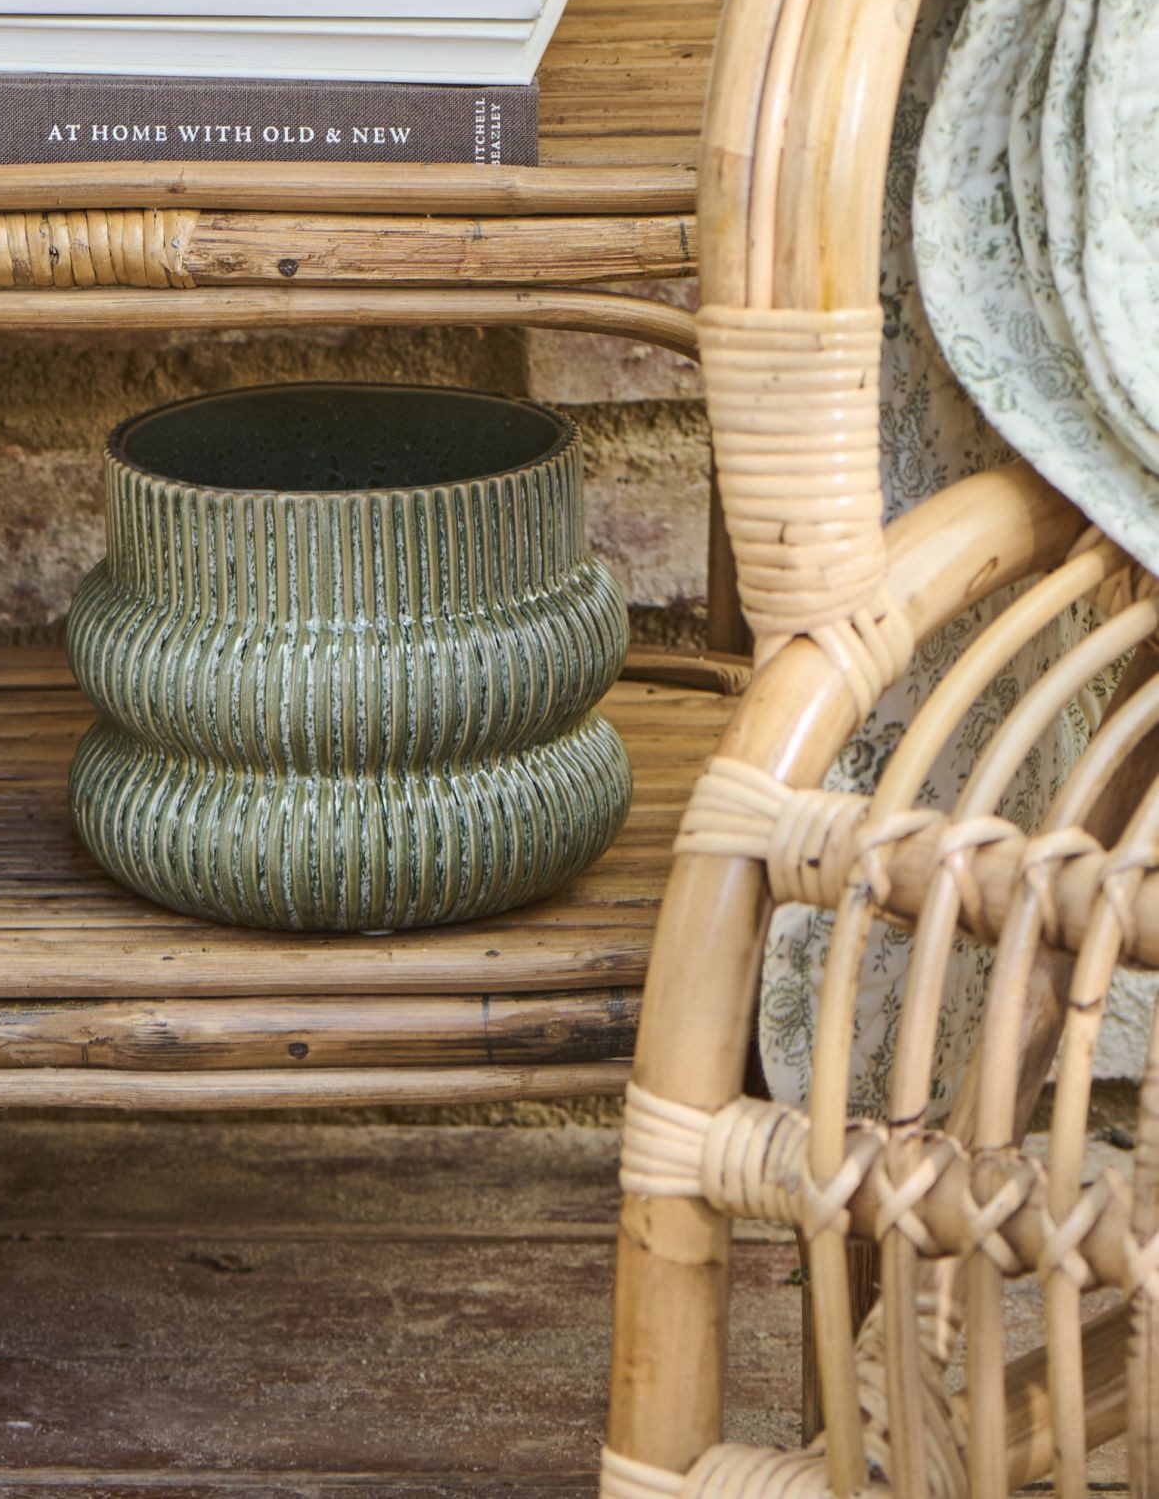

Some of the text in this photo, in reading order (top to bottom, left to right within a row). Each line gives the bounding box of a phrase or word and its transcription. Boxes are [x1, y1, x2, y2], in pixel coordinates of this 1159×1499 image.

[47, 123, 413, 145] AT HOME WITH OLD & NEW
